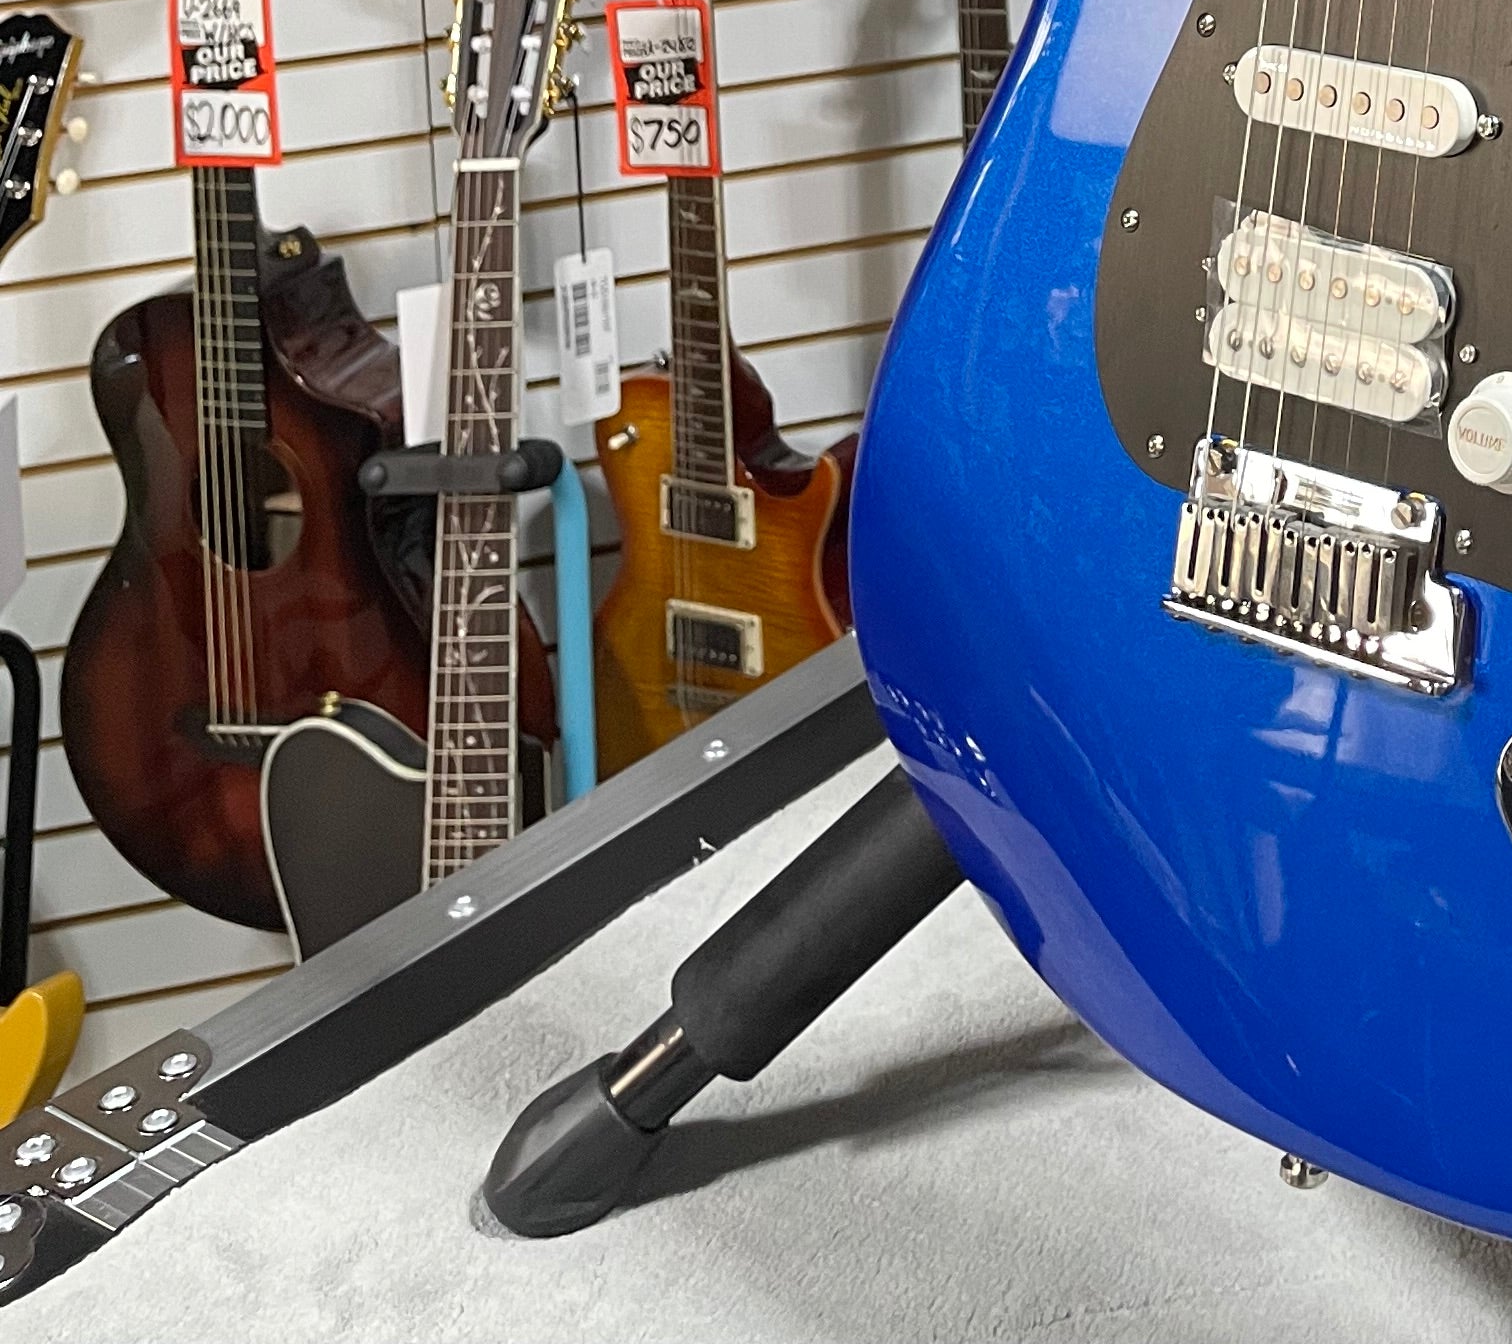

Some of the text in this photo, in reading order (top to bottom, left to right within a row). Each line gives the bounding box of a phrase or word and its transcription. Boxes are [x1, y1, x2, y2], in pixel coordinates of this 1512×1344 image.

[196, 42, 245, 66] OUR
[190, 58, 257, 86] PRICE
[639, 59, 685, 82] OUR
[634, 73, 696, 100] PRICE
[185, 100, 271, 149] $2,000
[629, 115, 700, 155] $750
[1459, 426, 1505, 452] VOLUME
